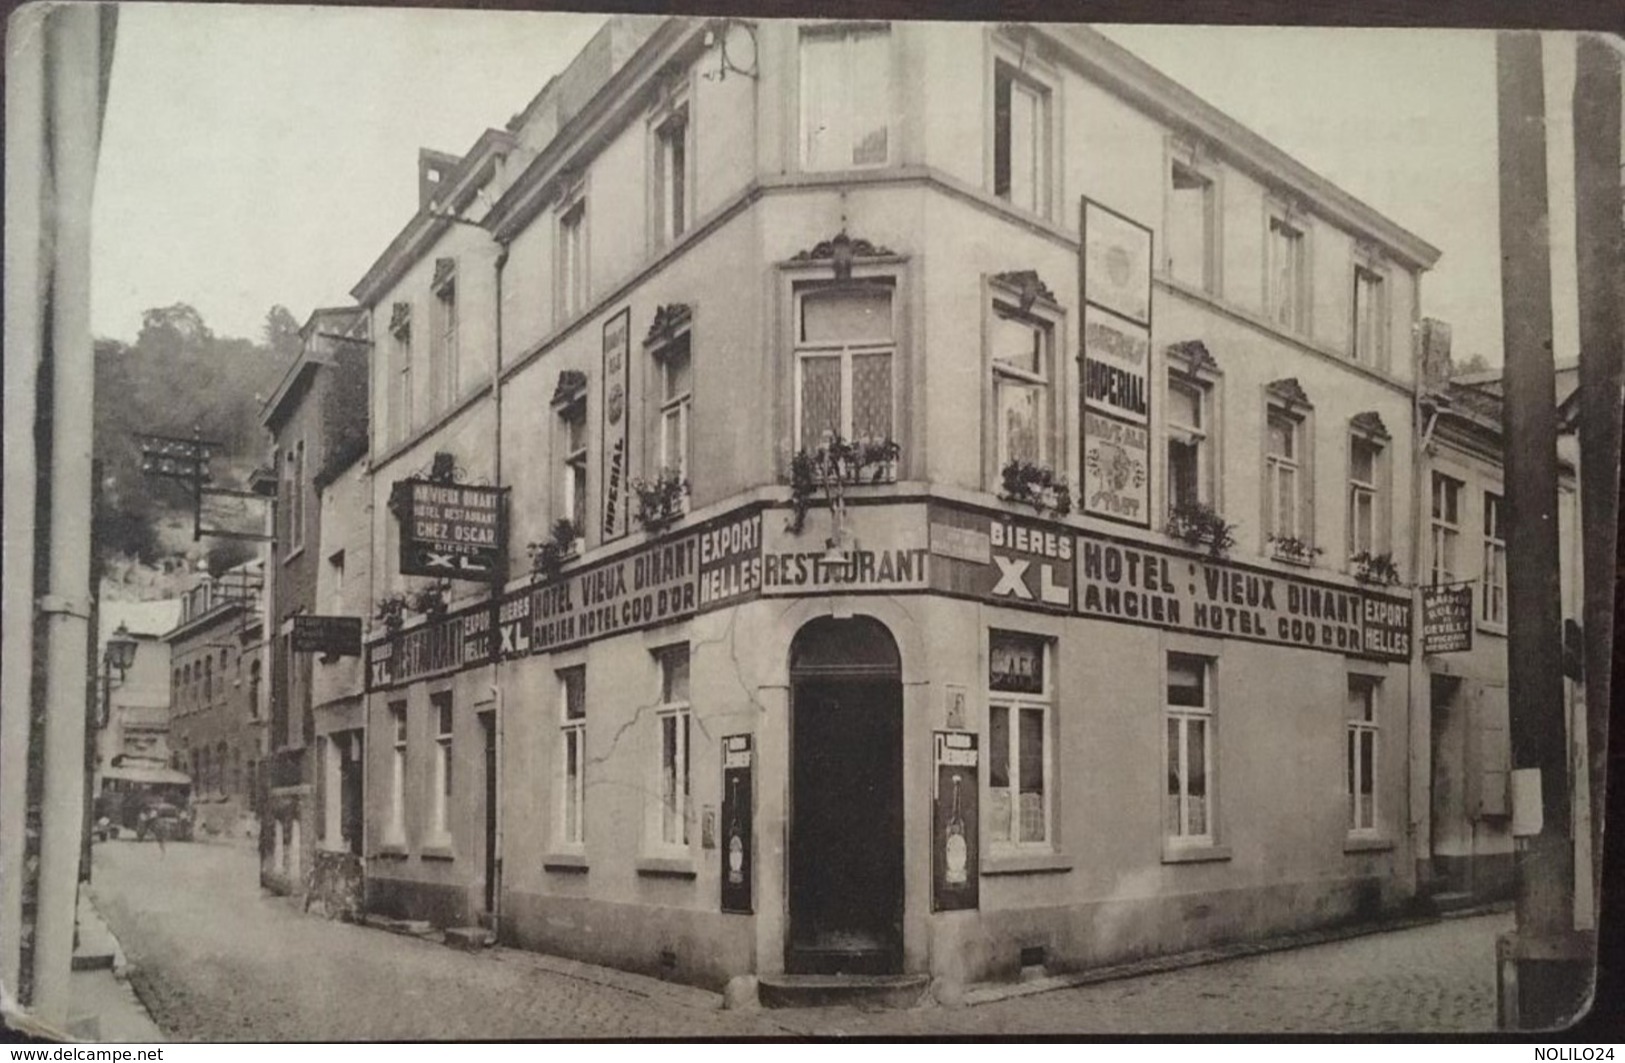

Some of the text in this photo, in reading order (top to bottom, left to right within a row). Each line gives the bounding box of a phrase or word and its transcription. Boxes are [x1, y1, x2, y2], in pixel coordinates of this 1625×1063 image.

[416, 521, 495, 543] CHEZ OSCAR
[701, 515, 761, 564] EXPORT
[990, 521, 1071, 560] BIERES
[426, 552, 486, 571] XL
[532, 539, 696, 622] HOTEL VIEUX DINANT
[701, 557, 761, 604] HELLES
[764, 549, 928, 586] RESTAURANT
[992, 555, 1070, 605] XL
[1084, 542, 1175, 593] HOTEL
[1204, 566, 1276, 610] VIEUX
[1287, 584, 1360, 625] DINANT
[579, 600, 617, 637] HOTEL
[1085, 584, 1180, 624] ANCIEN
[1194, 602, 1266, 635] HOTEL
[1365, 599, 1409, 628] EXPORT
[500, 622, 530, 653] XL
[1364, 628, 1409, 656] HELLES
